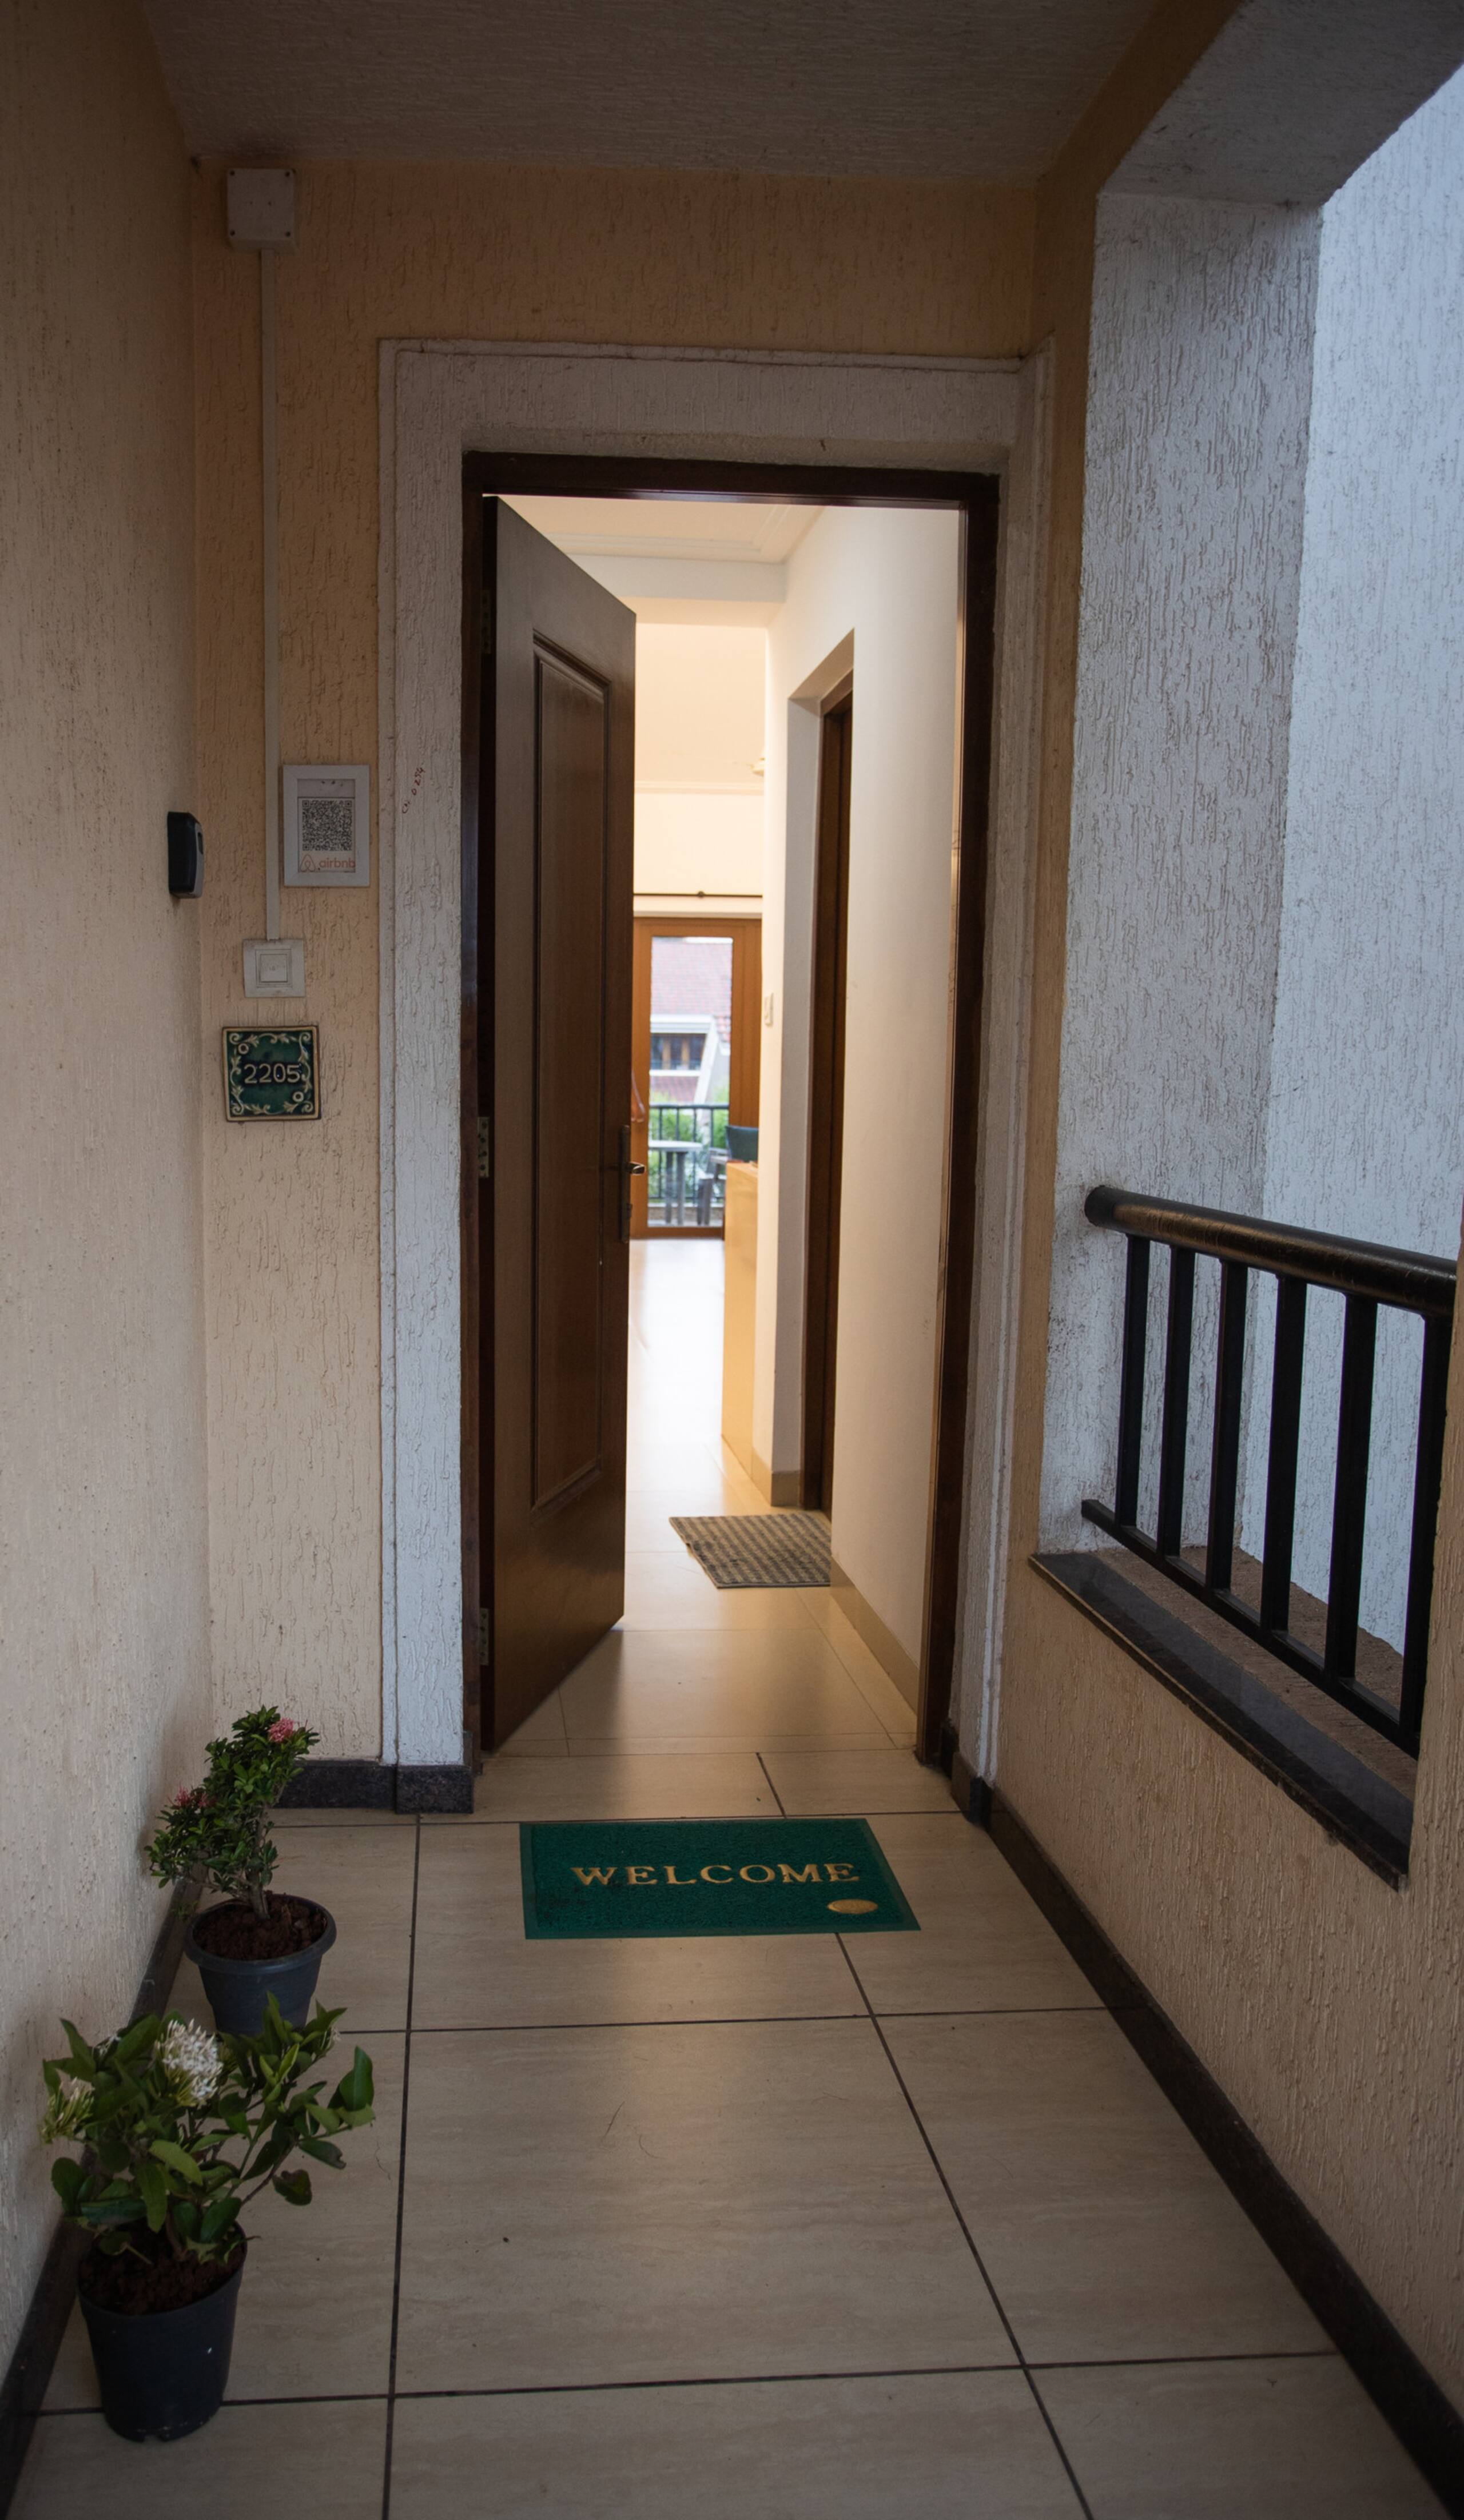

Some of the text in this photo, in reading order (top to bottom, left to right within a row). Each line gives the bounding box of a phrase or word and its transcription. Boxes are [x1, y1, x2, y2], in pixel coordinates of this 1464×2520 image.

[319, 857, 356, 868] airbnb
[244, 1063, 300, 1084] 2205
[571, 1863, 860, 1885] WELCOME
